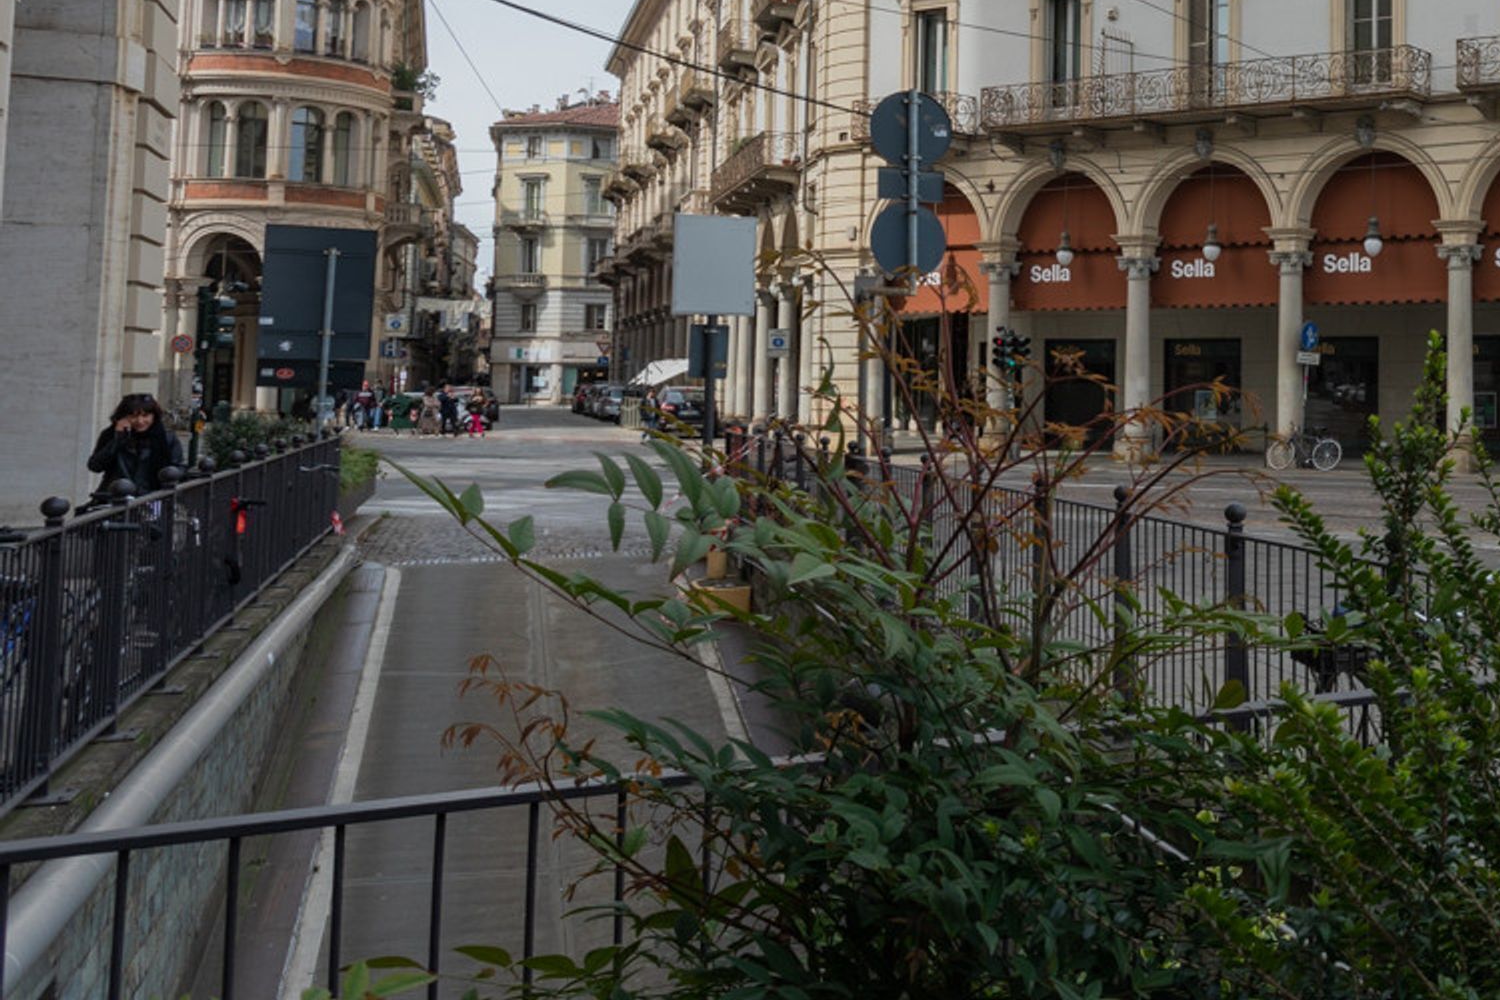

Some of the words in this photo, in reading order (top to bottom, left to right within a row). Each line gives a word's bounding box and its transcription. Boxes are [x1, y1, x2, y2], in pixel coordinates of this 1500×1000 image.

[1171, 258, 1215, 278] Sella
[1323, 252, 1371, 273] Sella
[1031, 264, 1070, 282] Sella
